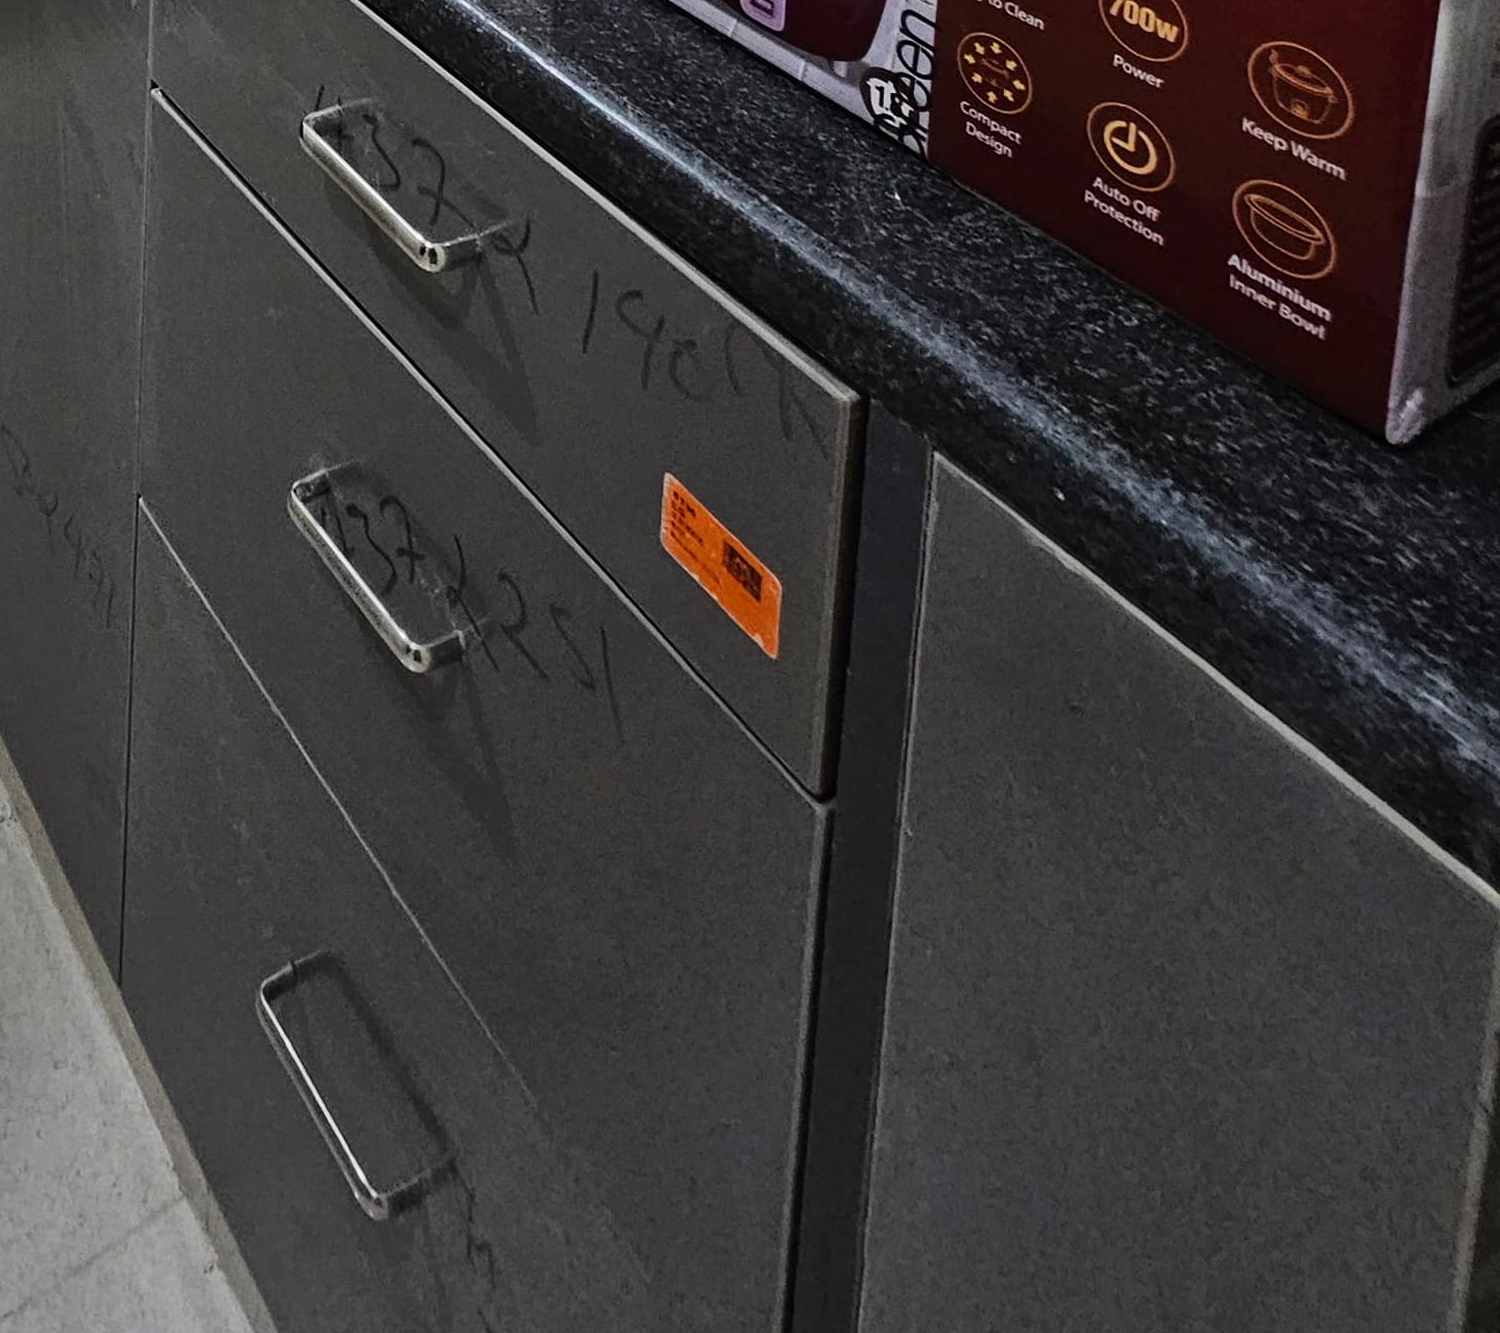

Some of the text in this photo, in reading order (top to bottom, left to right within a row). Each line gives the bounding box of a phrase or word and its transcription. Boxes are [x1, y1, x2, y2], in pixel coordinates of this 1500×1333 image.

[1003, 0, 1046, 31] Clean
[1111, 53, 1165, 90] Power
[959, 99, 1023, 146] Compact
[964, 120, 1014, 159] Design
[1241, 116, 1348, 182] Keep Warm
[1083, 188, 1165, 247] Protection
[1091, 175, 1163, 223] Auto Off
[1227, 253, 1333, 324] Aluminium
[1228, 273, 1327, 341] Inner Bowl
